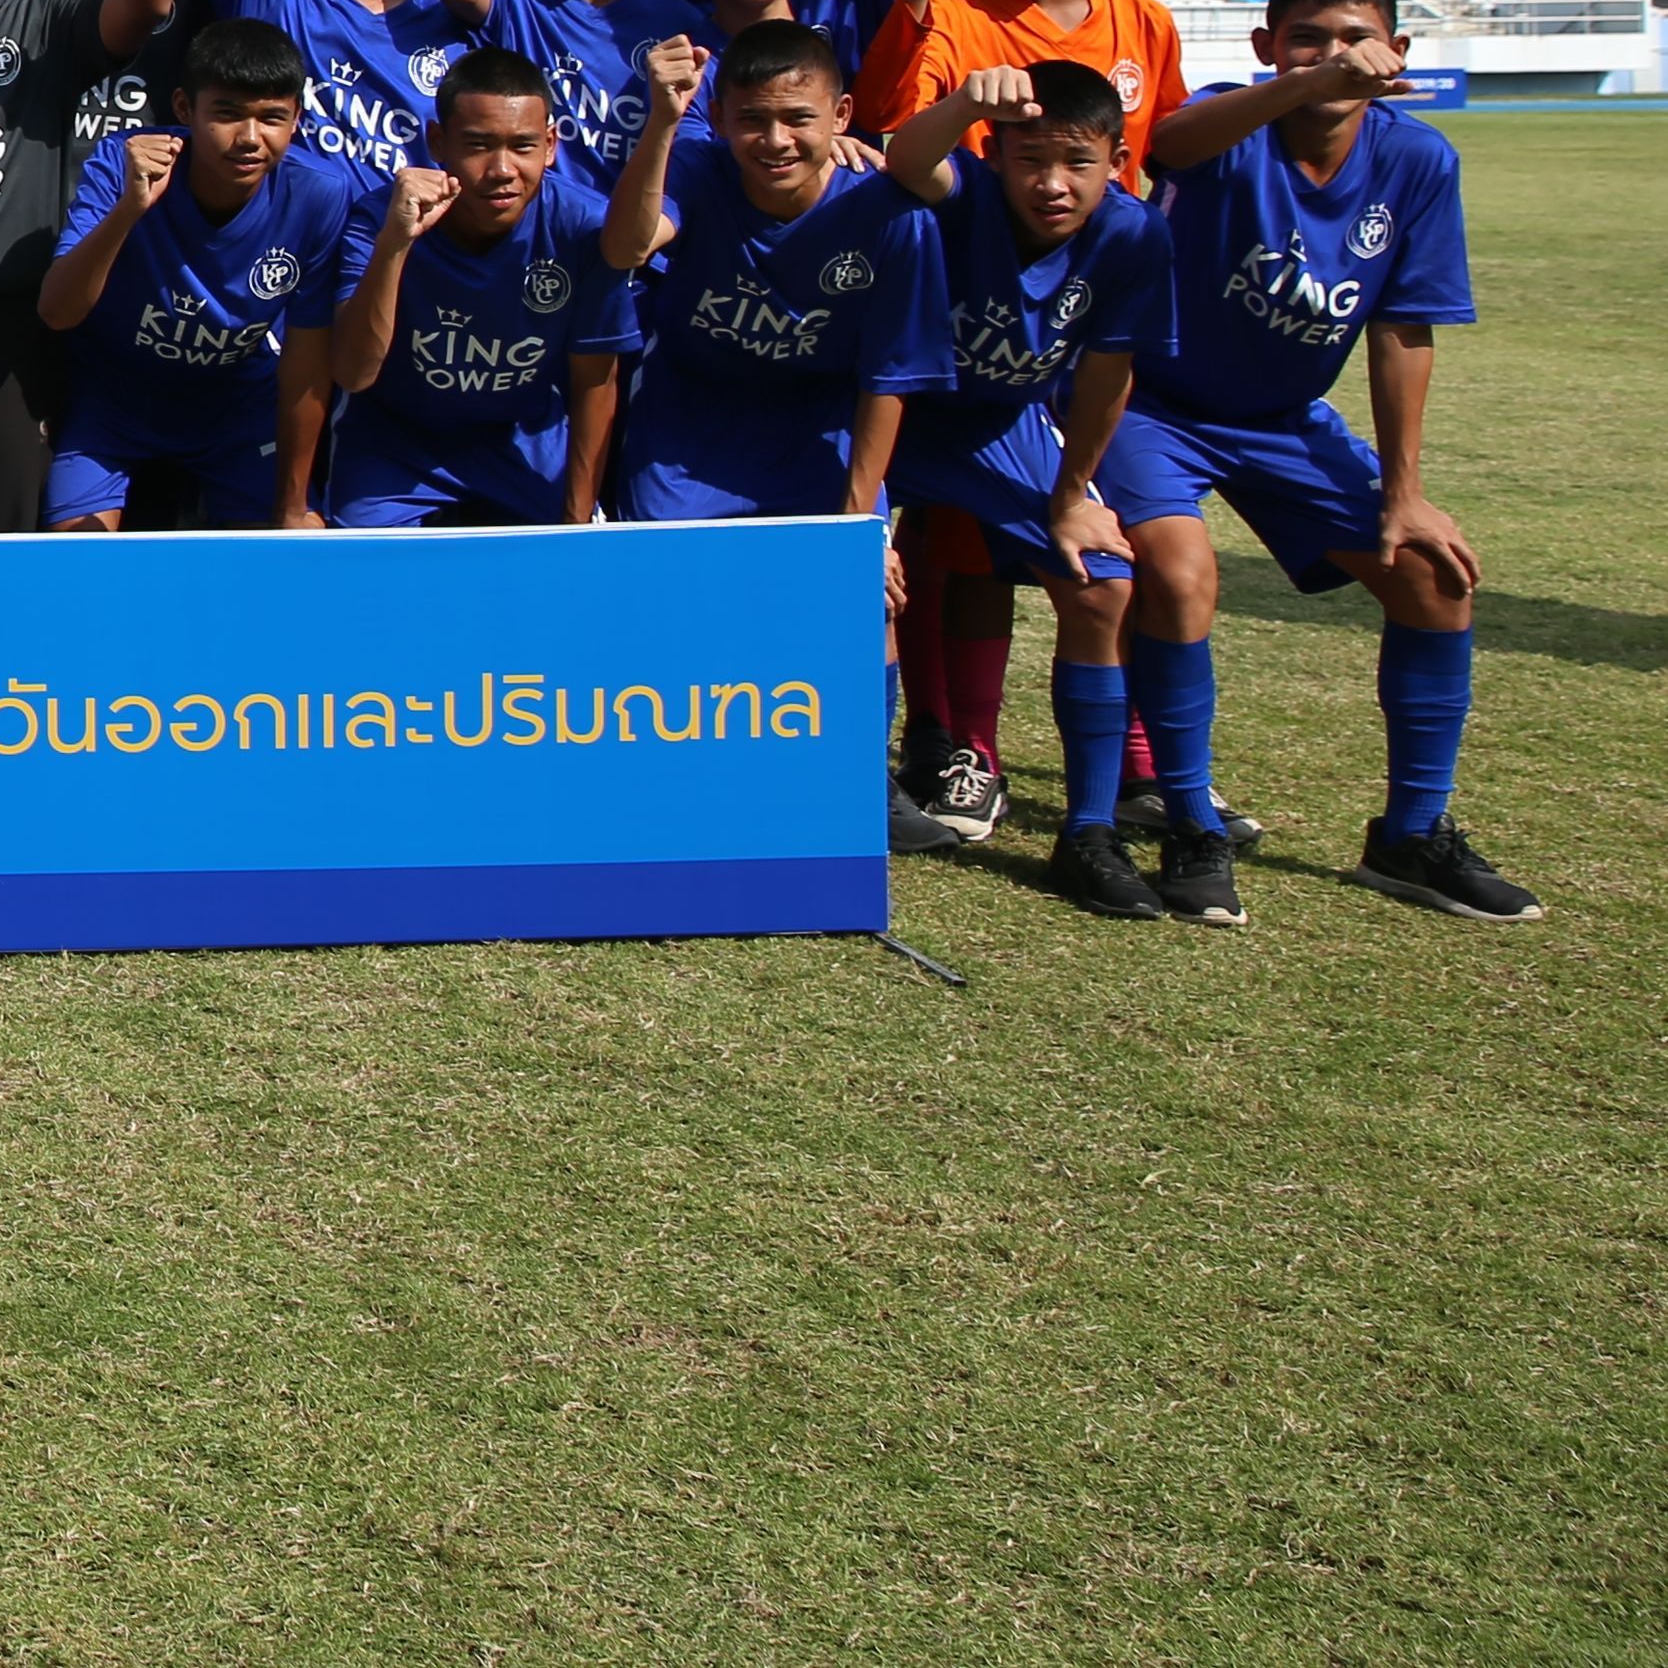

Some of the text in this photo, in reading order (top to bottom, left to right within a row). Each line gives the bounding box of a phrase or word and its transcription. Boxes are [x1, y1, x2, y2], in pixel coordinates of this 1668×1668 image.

[302, 76, 418, 145] KING
[1223, 274, 1350, 346] POWER
[1240, 243, 1361, 319] KING
[140, 304, 271, 348] KING
[696, 289, 832, 338] KING
[411, 329, 545, 368] KING
